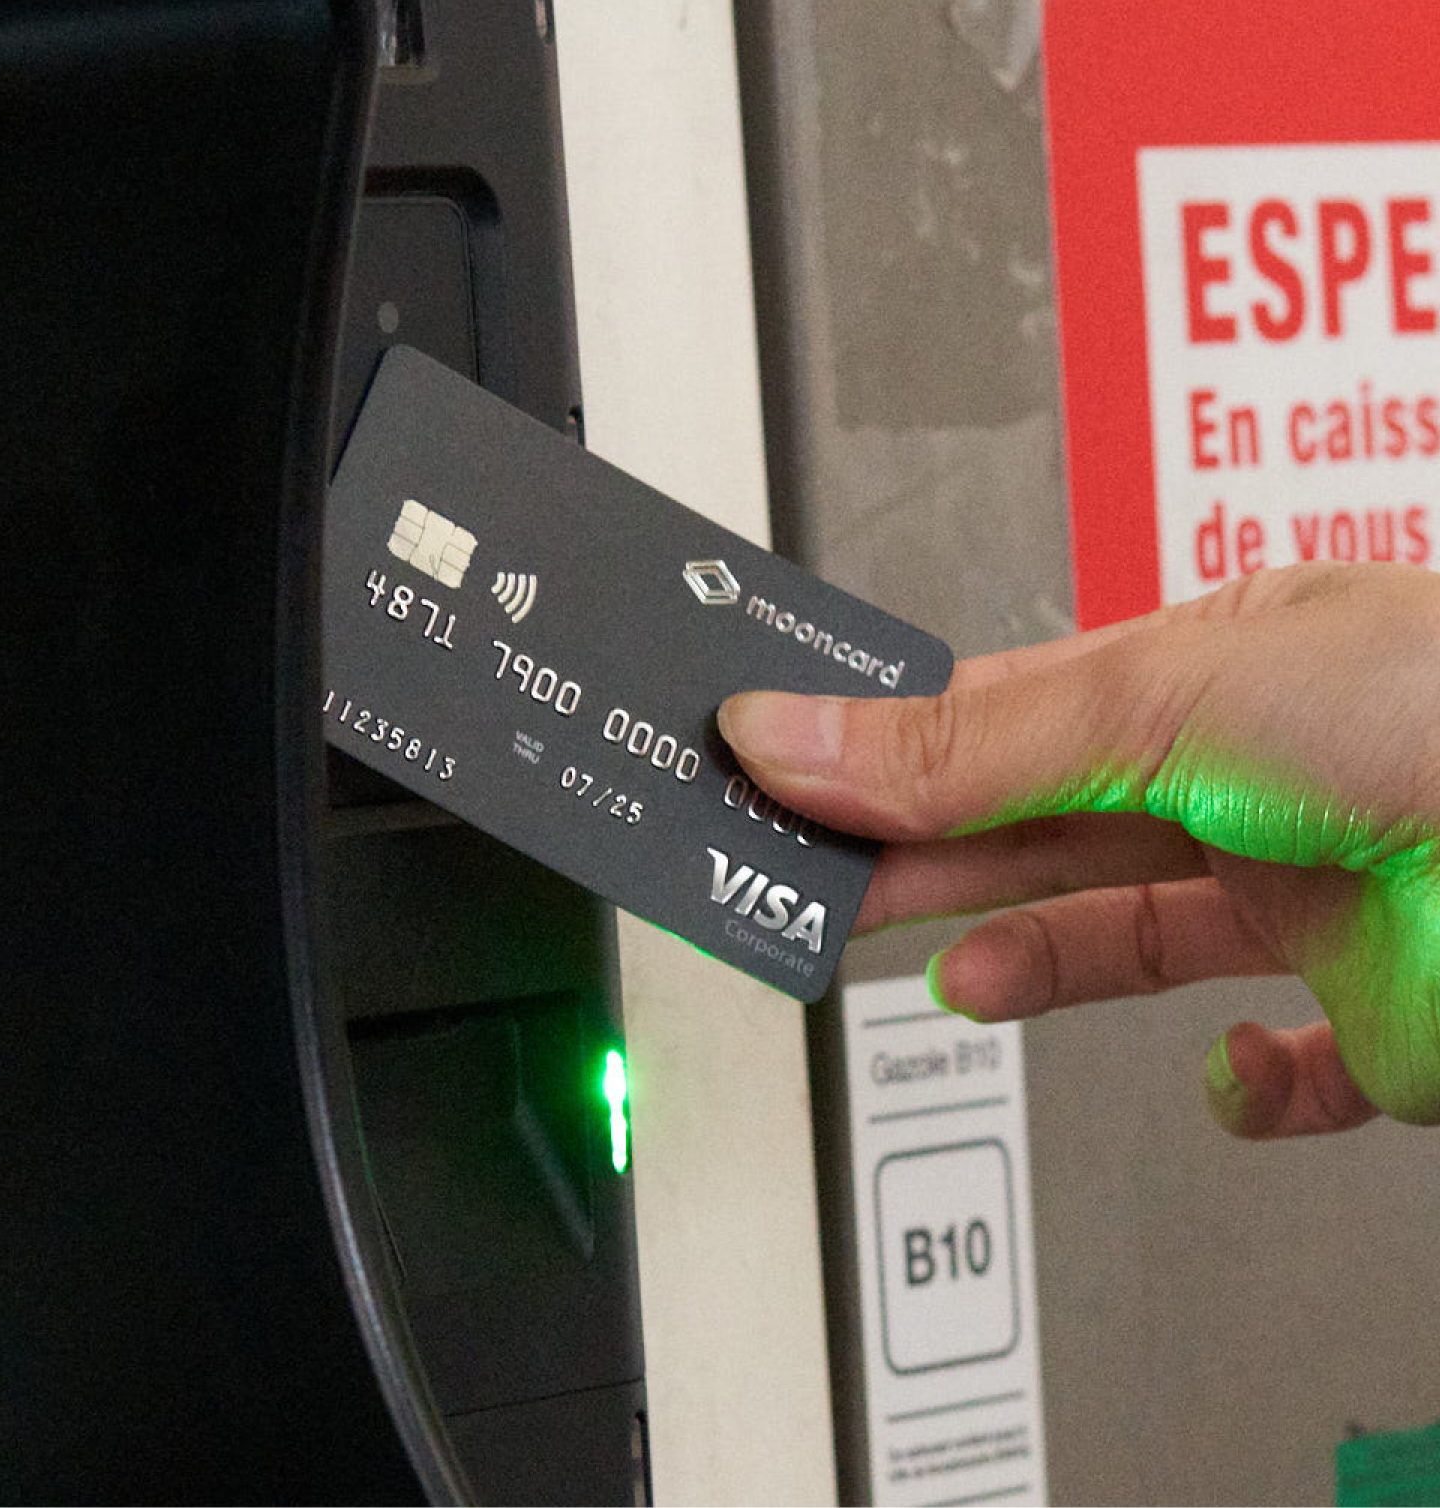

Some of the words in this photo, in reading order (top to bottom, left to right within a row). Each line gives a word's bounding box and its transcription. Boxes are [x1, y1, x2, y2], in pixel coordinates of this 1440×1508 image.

[1188, 386, 1261, 473] En
[1194, 500, 1266, 583] de
[1291, 504, 1430, 568] vous
[366, 569, 456, 650] 4871
[493, 640, 582, 716] 7900
[603, 707, 701, 782] 0000
[746, 595, 906, 690] mooncard
[322, 690, 457, 780] 11235813
[513, 742, 541, 764] THRU
[515, 730, 545, 752] VALID
[560, 766, 644, 825] 07/25
[706, 846, 827, 954] VISA
[724, 919, 815, 978] Corporate
[956, 1036, 1002, 1075] B10
[903, 1218, 992, 1288] B10
